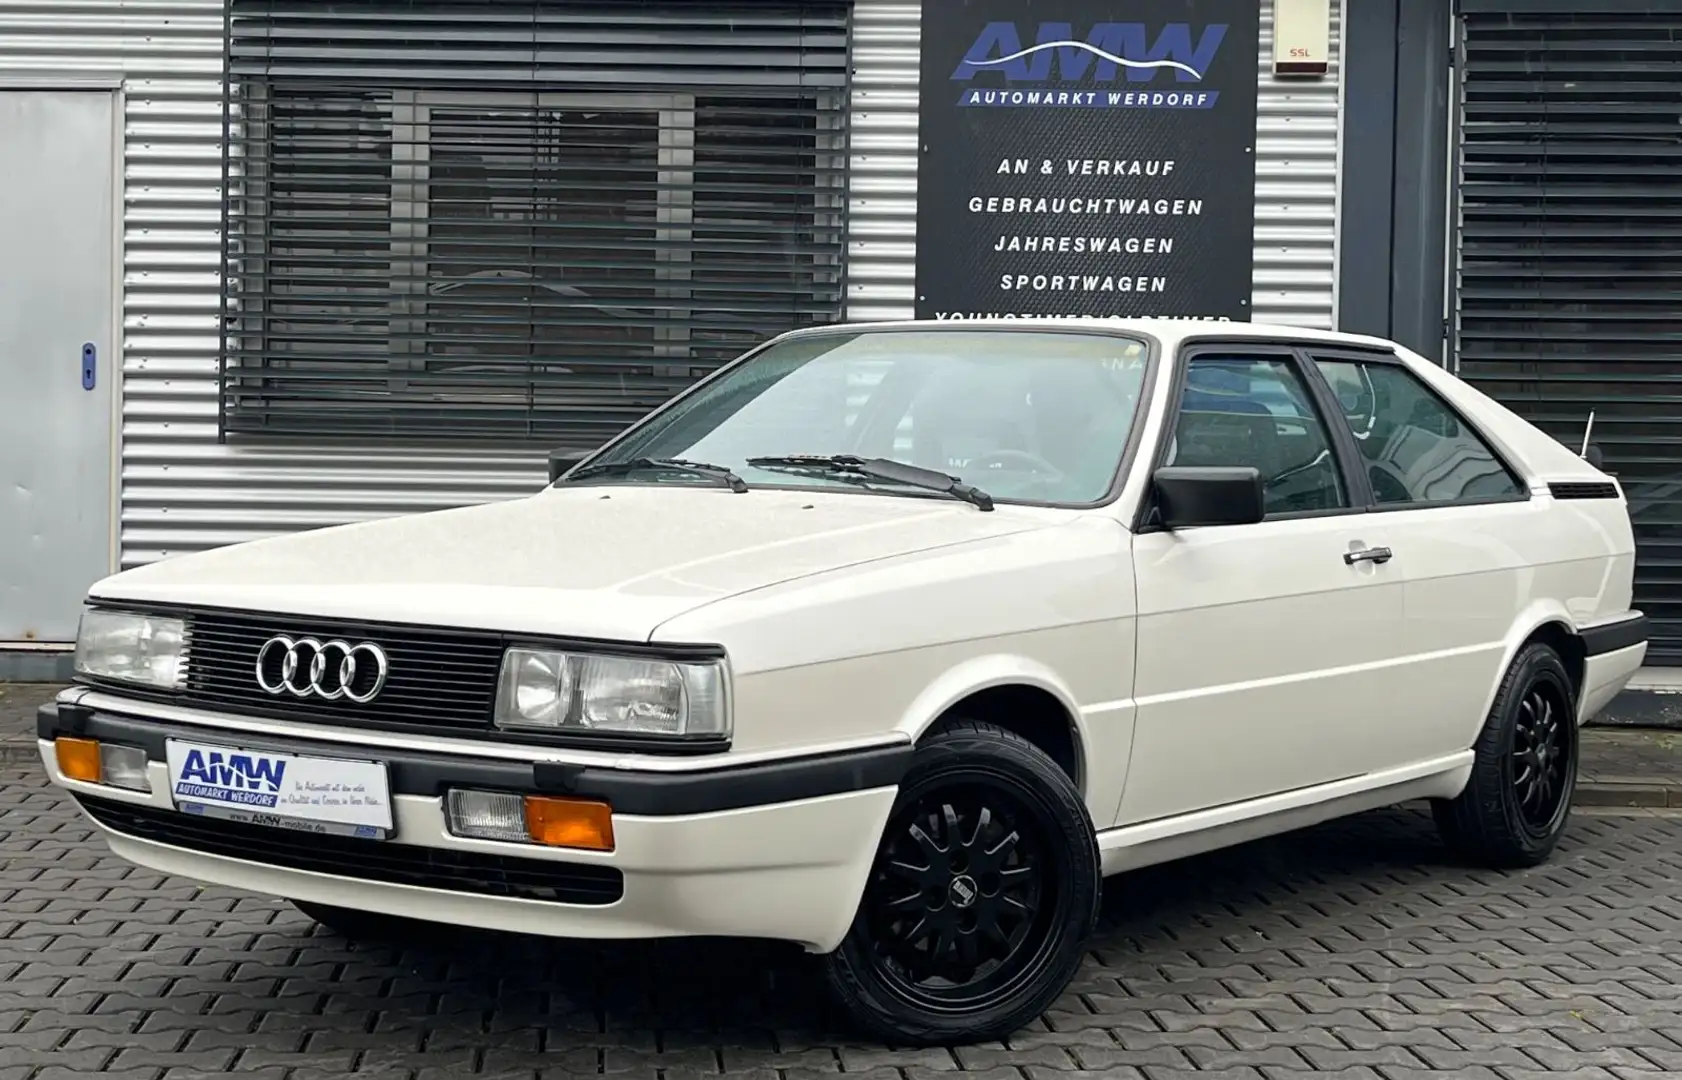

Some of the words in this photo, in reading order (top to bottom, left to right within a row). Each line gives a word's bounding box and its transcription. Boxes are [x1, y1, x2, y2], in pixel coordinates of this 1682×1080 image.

[949, 22, 1229, 81] AMW
[969, 91, 1096, 105] AUTOMARKT
[1108, 92, 1207, 106] WERDORF
[996, 158, 1029, 174] AN
[1040, 159, 1054, 175] &
[1066, 159, 1176, 176] VERKAUF
[968, 196, 1203, 215] GEBRAUCHTWAGEN
[994, 236, 1173, 254] JAHRESWAGEN
[1000, 274, 1166, 292] SPORTWAGEN
[180, 749, 286, 792] AMW
[178, 783, 228, 799] AUTOMARKT
[231, 792, 274, 806] WERDORF
